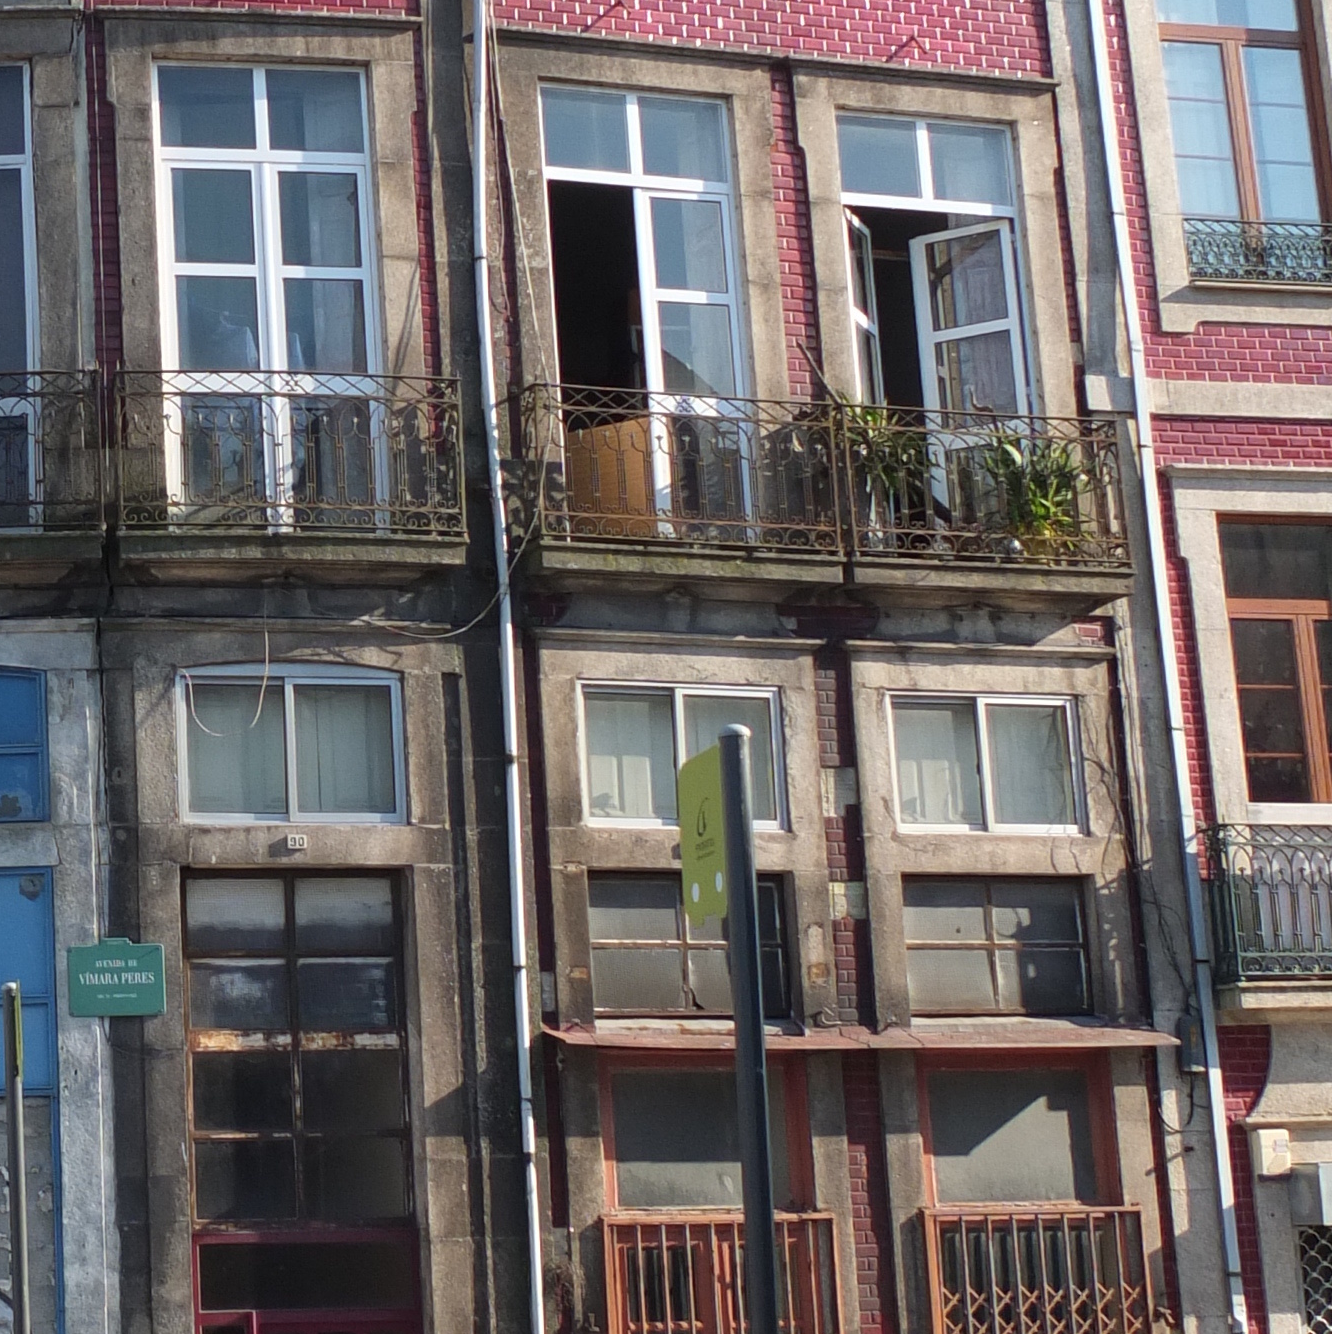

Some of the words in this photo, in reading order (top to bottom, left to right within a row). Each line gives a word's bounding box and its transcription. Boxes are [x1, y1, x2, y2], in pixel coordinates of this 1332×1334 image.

[290, 836, 305, 847] 90
[95, 959, 126, 968] AVENIDA
[78, 971, 119, 985] VÍMARA
[121, 971, 155, 984] PERES
